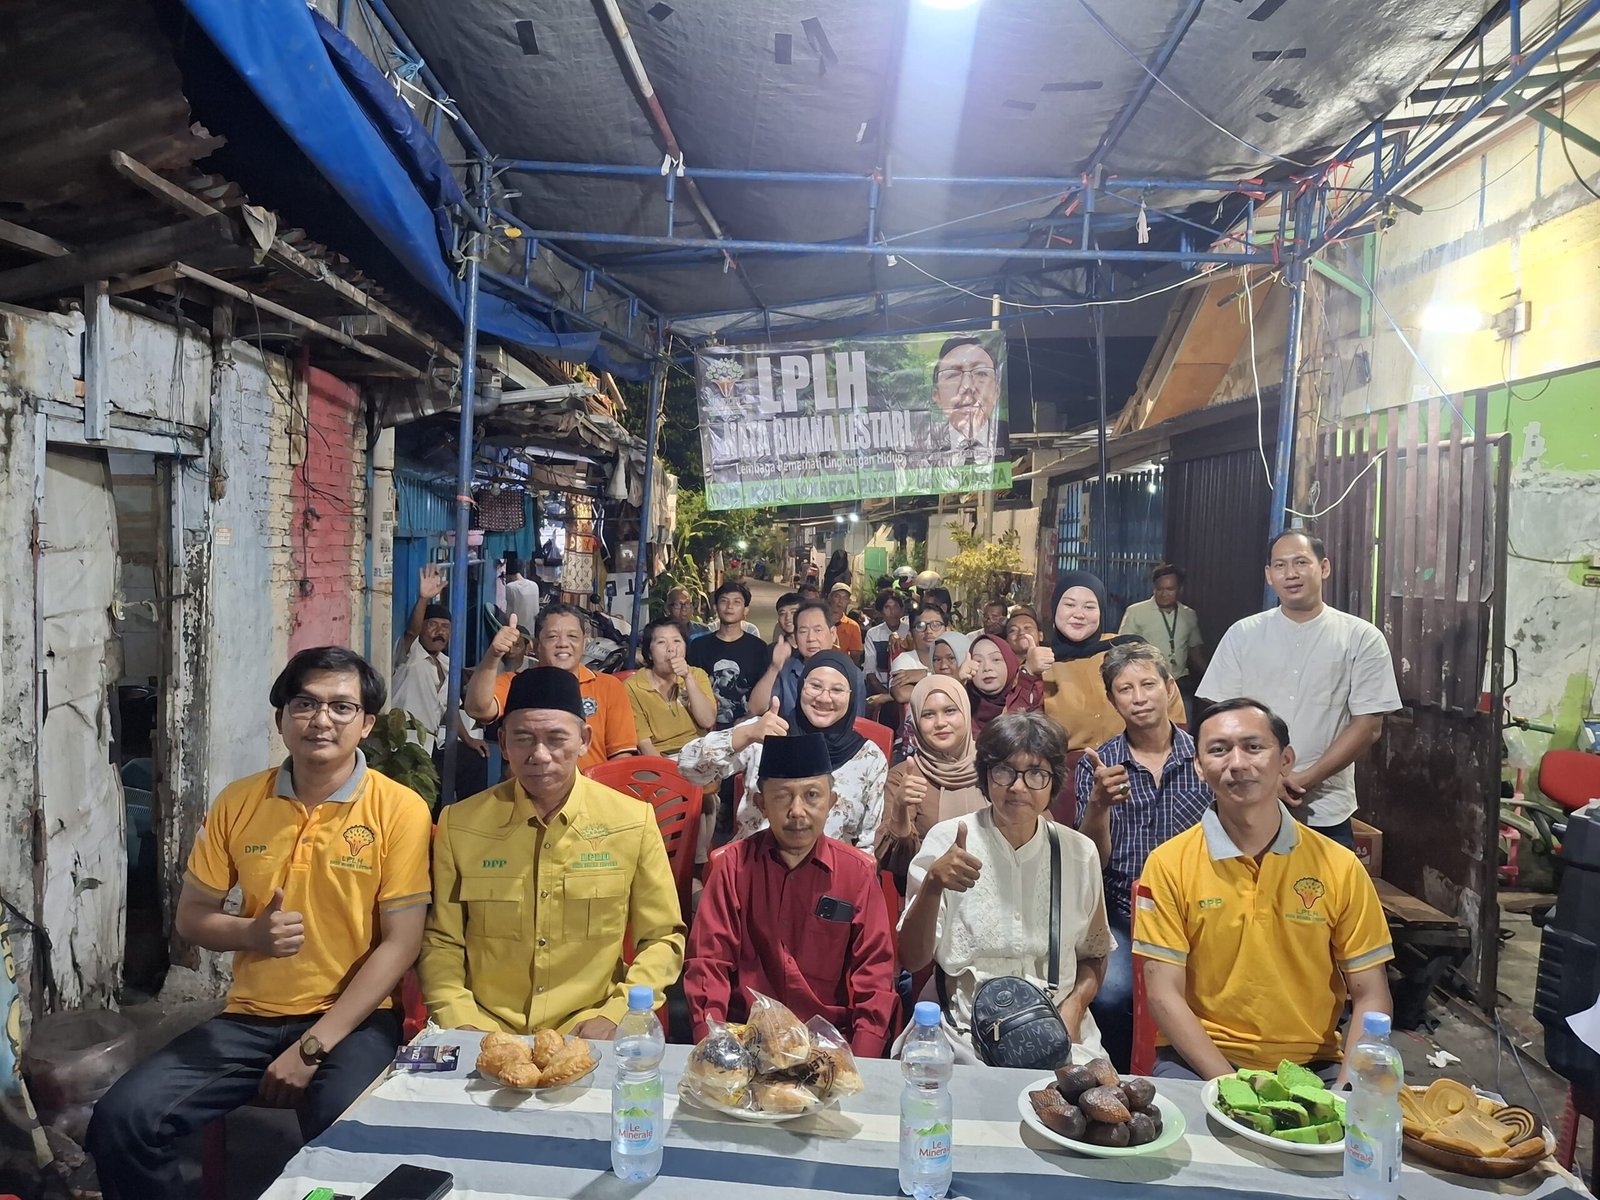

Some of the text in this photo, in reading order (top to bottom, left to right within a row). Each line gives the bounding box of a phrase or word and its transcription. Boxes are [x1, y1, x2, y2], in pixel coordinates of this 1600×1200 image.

[756, 351, 868, 414] LPLH
[773, 416, 837, 456] BUANA
[735, 461, 775, 477] Lembaga
[777, 456, 822, 472] Pemerhati
[876, 450, 904, 465] Hidup
[860, 474, 898, 495] PUSA
[244, 845, 267, 854] DPP
[482, 859, 507, 868] DPP
[1198, 898, 1222, 908] DPP
[629, 1122, 640, 1132] Le
[618, 1129, 654, 1140] Minerale
[932, 1140, 942, 1150] Le
[919, 1147, 950, 1157] Minera
